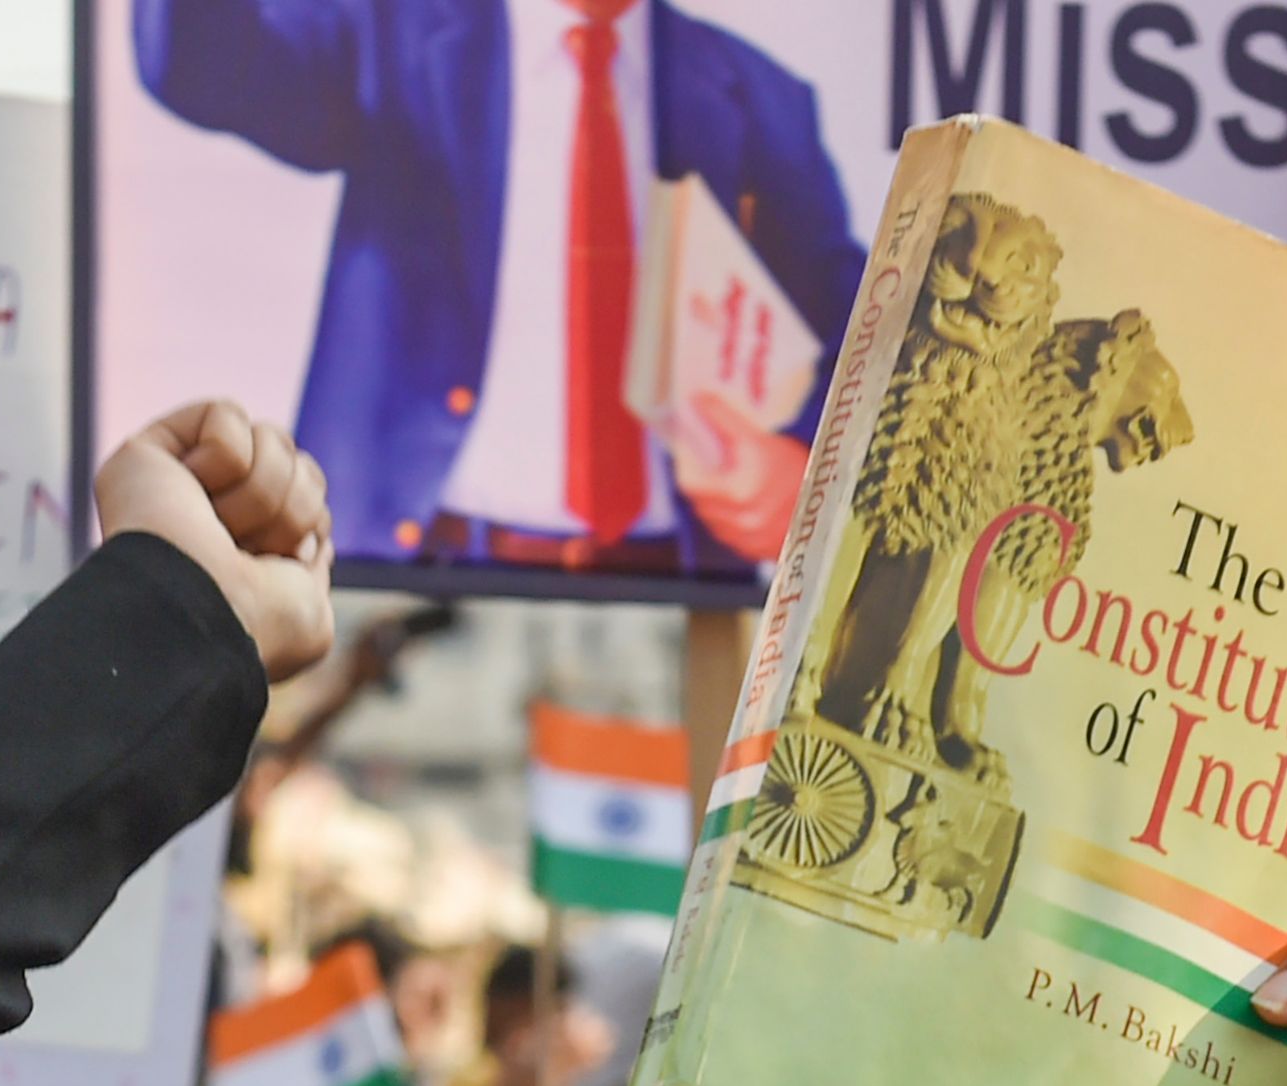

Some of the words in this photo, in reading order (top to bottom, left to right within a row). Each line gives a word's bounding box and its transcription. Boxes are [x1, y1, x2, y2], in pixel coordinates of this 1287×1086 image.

[887, 202, 922, 258] The
[786, 267, 902, 561] Constitution
[1170, 498, 1287, 617] The
[745, 590, 804, 708] India
[1085, 688, 1157, 767] of
[1024, 966, 1053, 1011] P.
[1062, 979, 1109, 1032] M.
